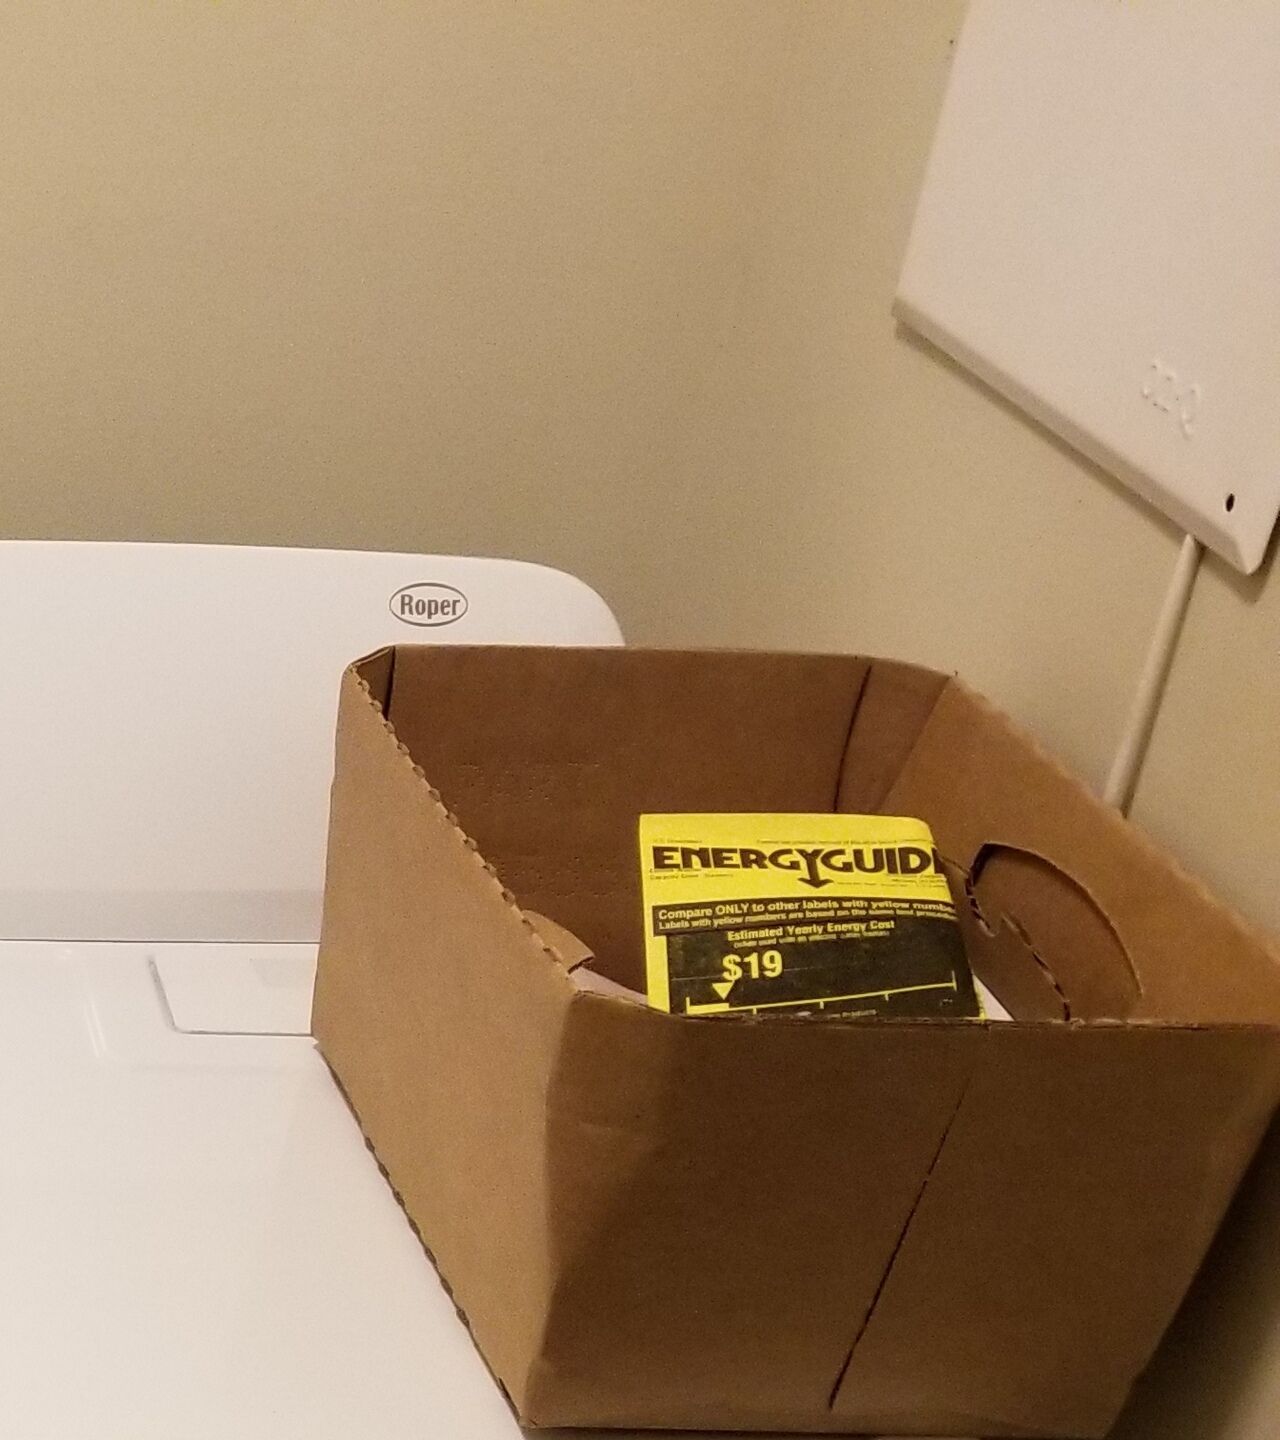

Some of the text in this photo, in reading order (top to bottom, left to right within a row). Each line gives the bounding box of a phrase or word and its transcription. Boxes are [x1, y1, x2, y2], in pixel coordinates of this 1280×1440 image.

[400, 594, 460, 619] Roper
[658, 909, 713, 922] Compare
[715, 902, 749, 915] ONLY
[752, 904, 764, 912] to
[767, 901, 800, 911] other
[802, 900, 839, 909] labels
[841, 900, 868, 909] with
[870, 901, 910, 909] yellow
[658, 921, 689, 930] Labels
[691, 918, 712, 928] with
[713, 916, 744, 928] yellow
[727, 927, 783, 941] Estimated
[786, 924, 824, 936] Yearly
[827, 921, 868, 934] Energy
[870, 920, 895, 930] Cost
[722, 950, 783, 981] $19
